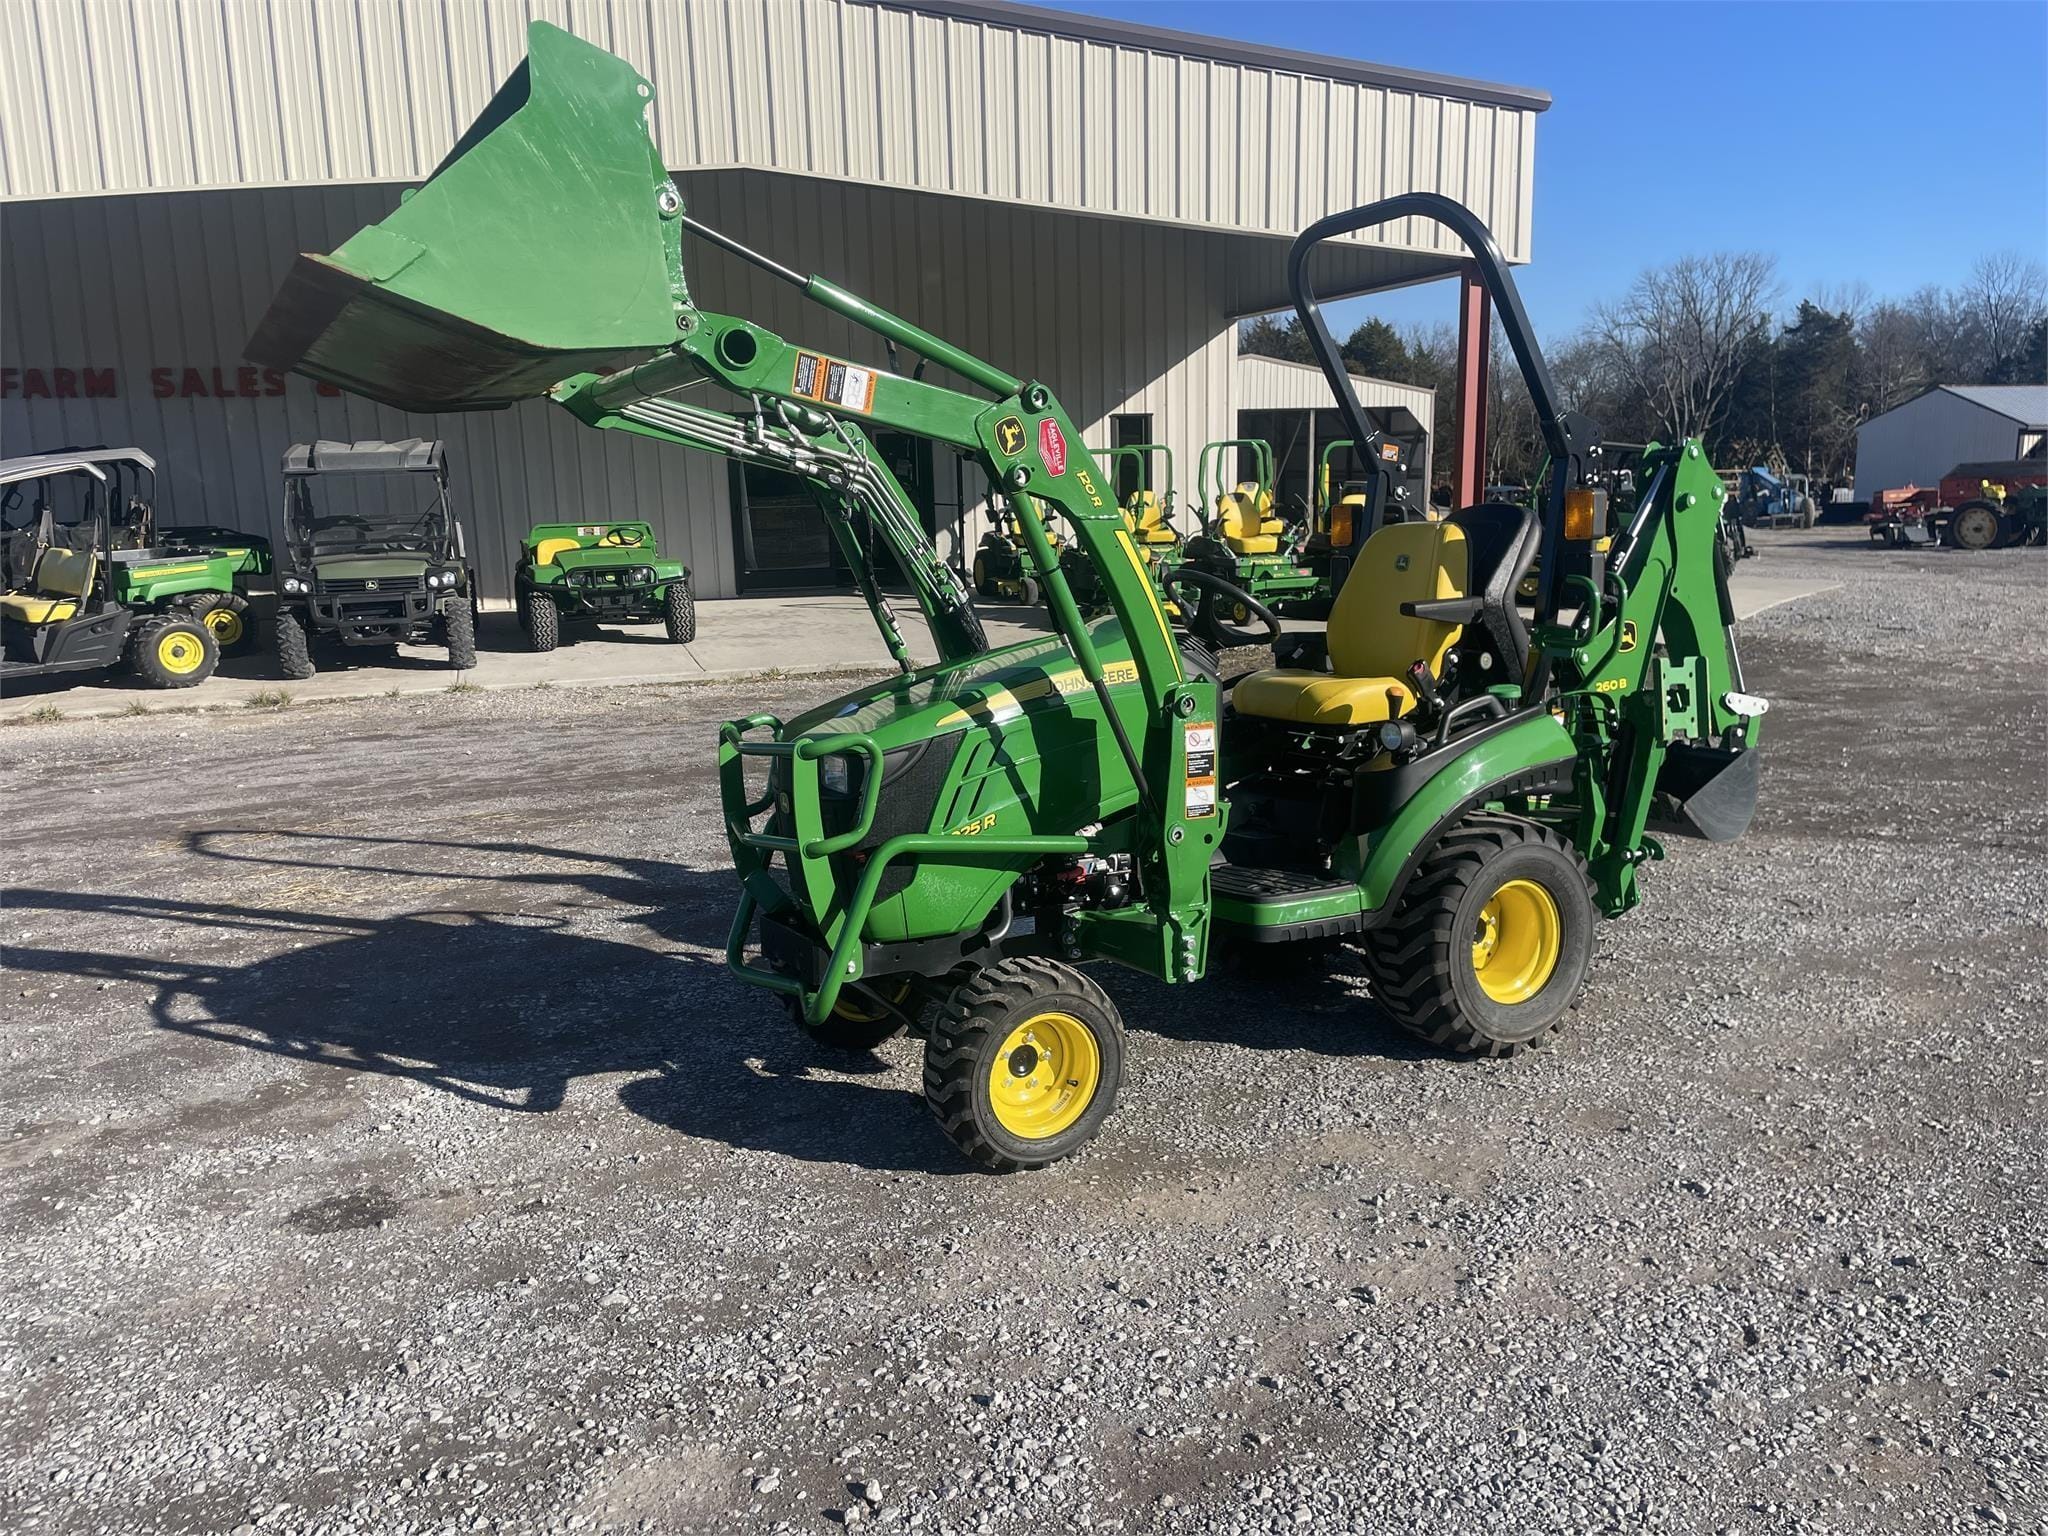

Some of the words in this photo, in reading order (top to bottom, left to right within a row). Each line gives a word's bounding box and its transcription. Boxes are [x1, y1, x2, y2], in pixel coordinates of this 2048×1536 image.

[0, 368, 117, 398] FARM
[150, 367, 287, 398] SALES
[1047, 422, 1065, 471] EAGLEVILLE
[1077, 470, 1096, 495] 120
[1090, 496, 1103, 507] R
[1596, 680, 1618, 692] 260
[1619, 678, 1627, 689] B
[984, 813, 997, 830] R
